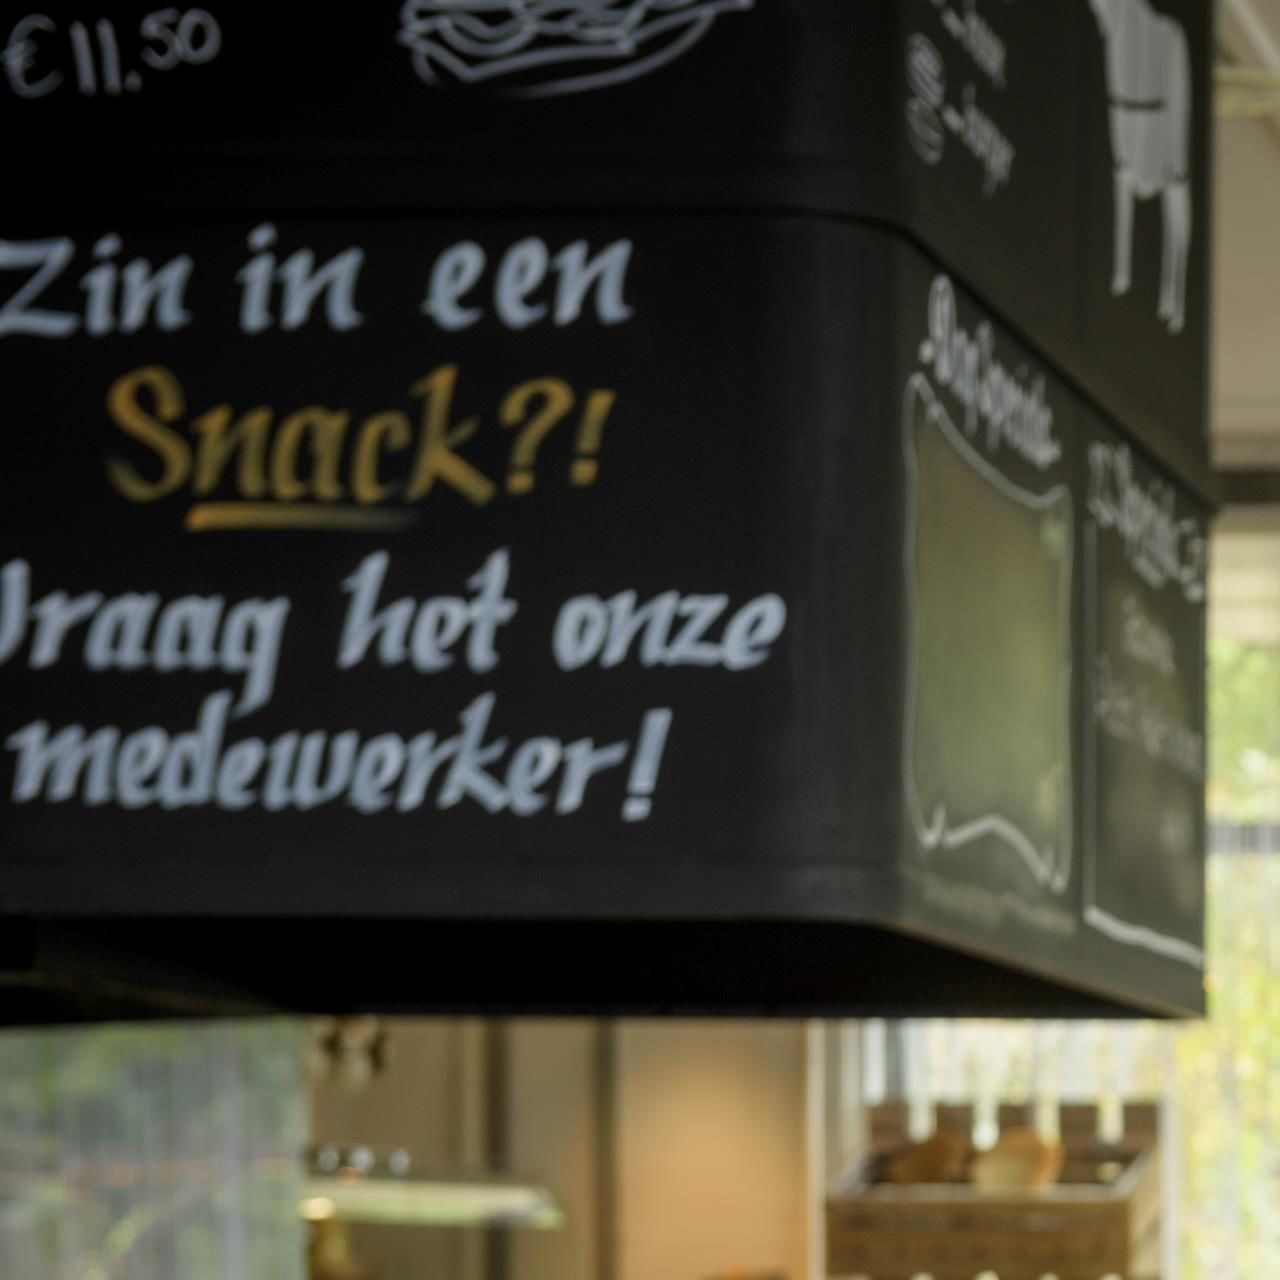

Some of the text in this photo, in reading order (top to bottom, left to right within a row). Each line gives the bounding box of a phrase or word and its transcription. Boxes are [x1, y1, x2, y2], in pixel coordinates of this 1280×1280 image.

[0, 223, 634, 337] Zin in een
[107, 364, 617, 503] Snack?!
[334, 546, 519, 675] het
[550, 588, 789, 673] onze
[5, 690, 675, 823] medewerker!
